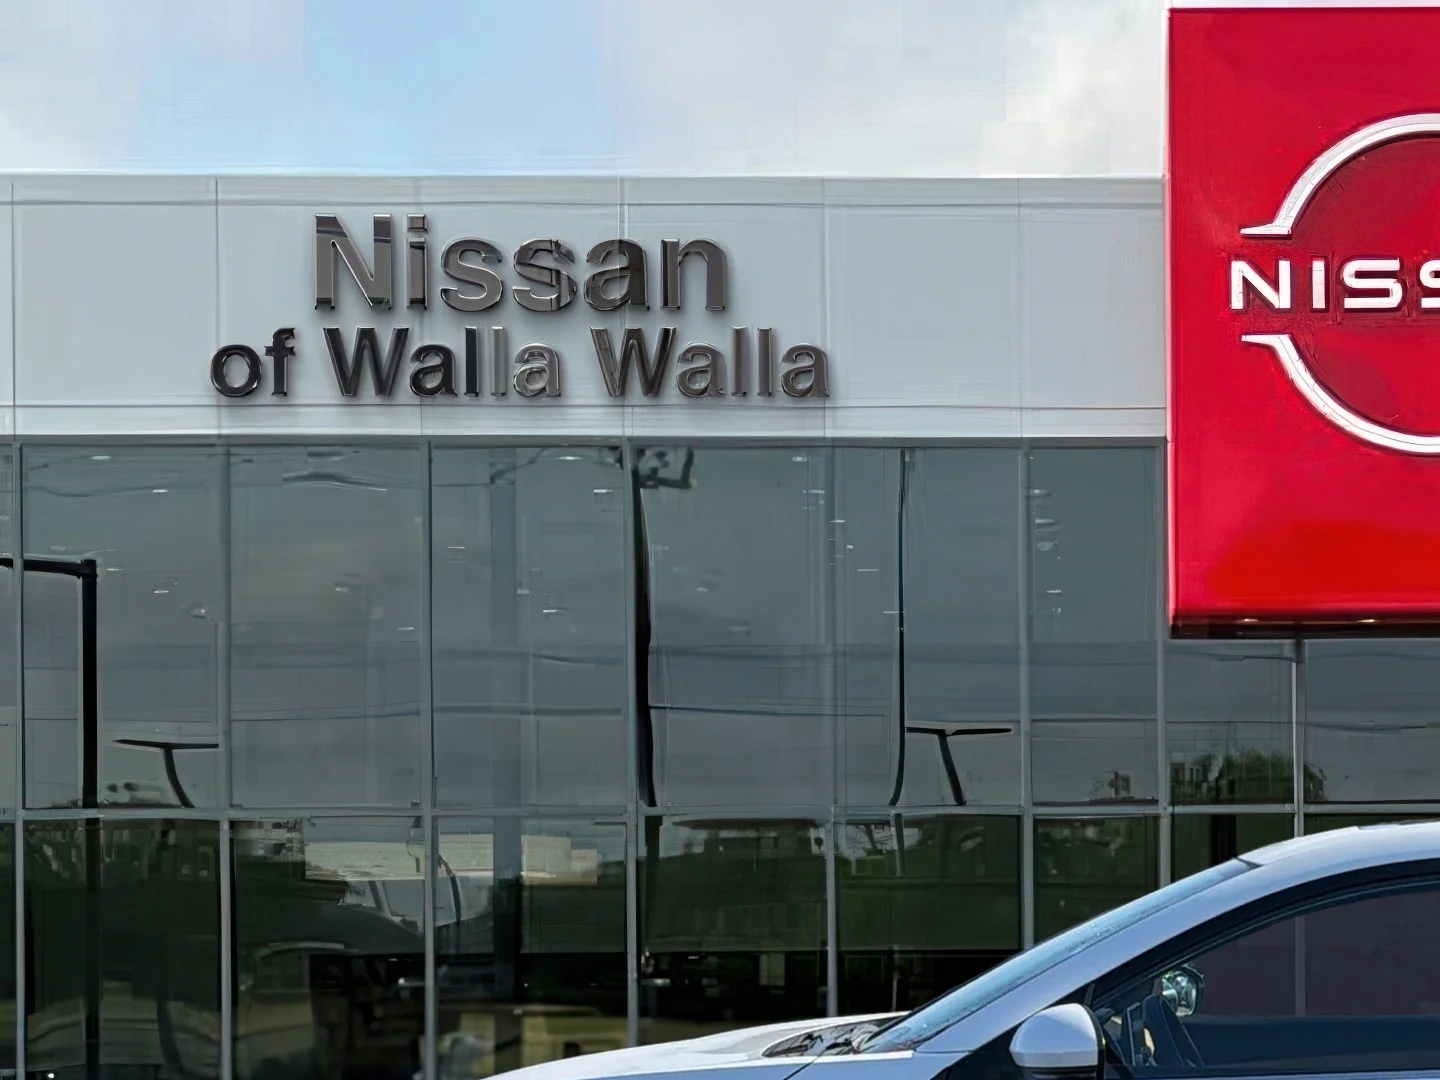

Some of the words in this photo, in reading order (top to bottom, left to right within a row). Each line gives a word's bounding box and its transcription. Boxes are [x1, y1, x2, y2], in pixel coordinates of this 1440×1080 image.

[314, 212, 728, 312] Nissan
[209, 326, 297, 398] of
[322, 325, 562, 398] Walla
[589, 325, 831, 398] Walla
